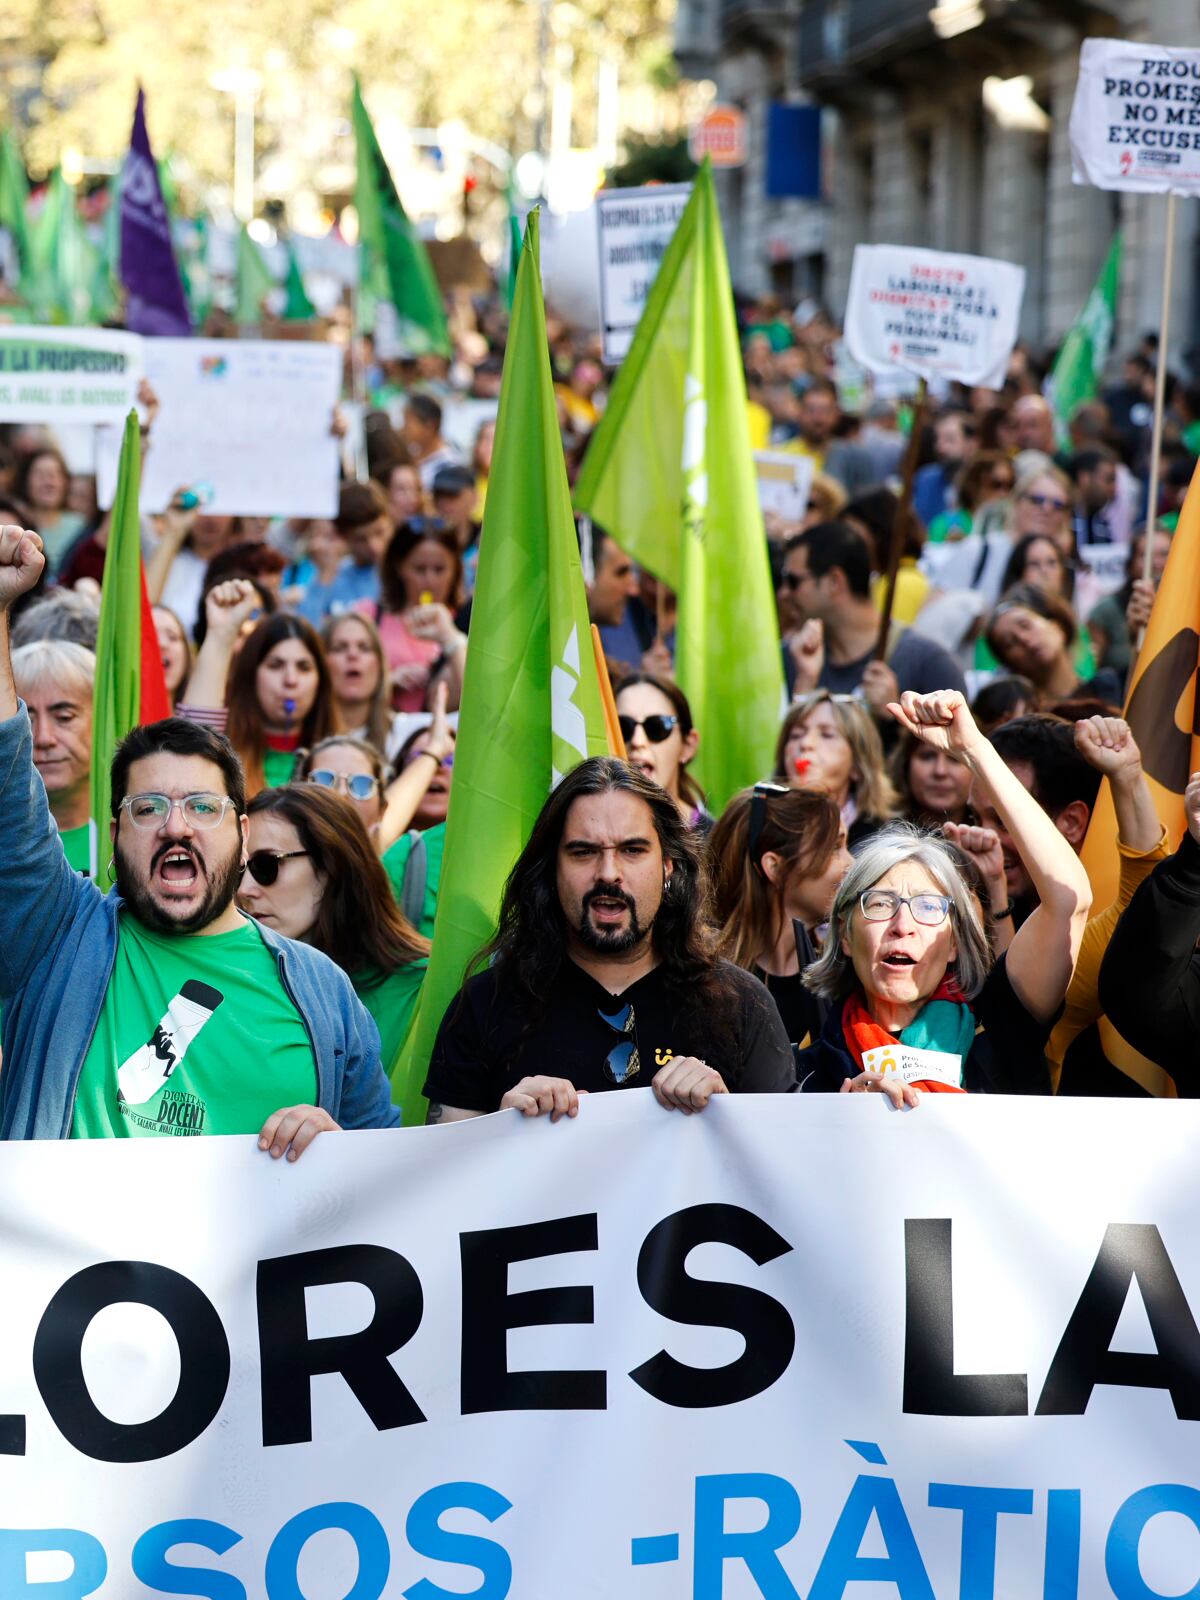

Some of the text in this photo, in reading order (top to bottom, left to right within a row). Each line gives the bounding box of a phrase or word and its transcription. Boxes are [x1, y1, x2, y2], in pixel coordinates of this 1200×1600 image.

[1125, 104, 1158, 122] NO
[163, 1090, 205, 1109] DIGNITAT
[157, 1100, 205, 1129] DOCENT
[902, 1218, 1200, 1421] LA
